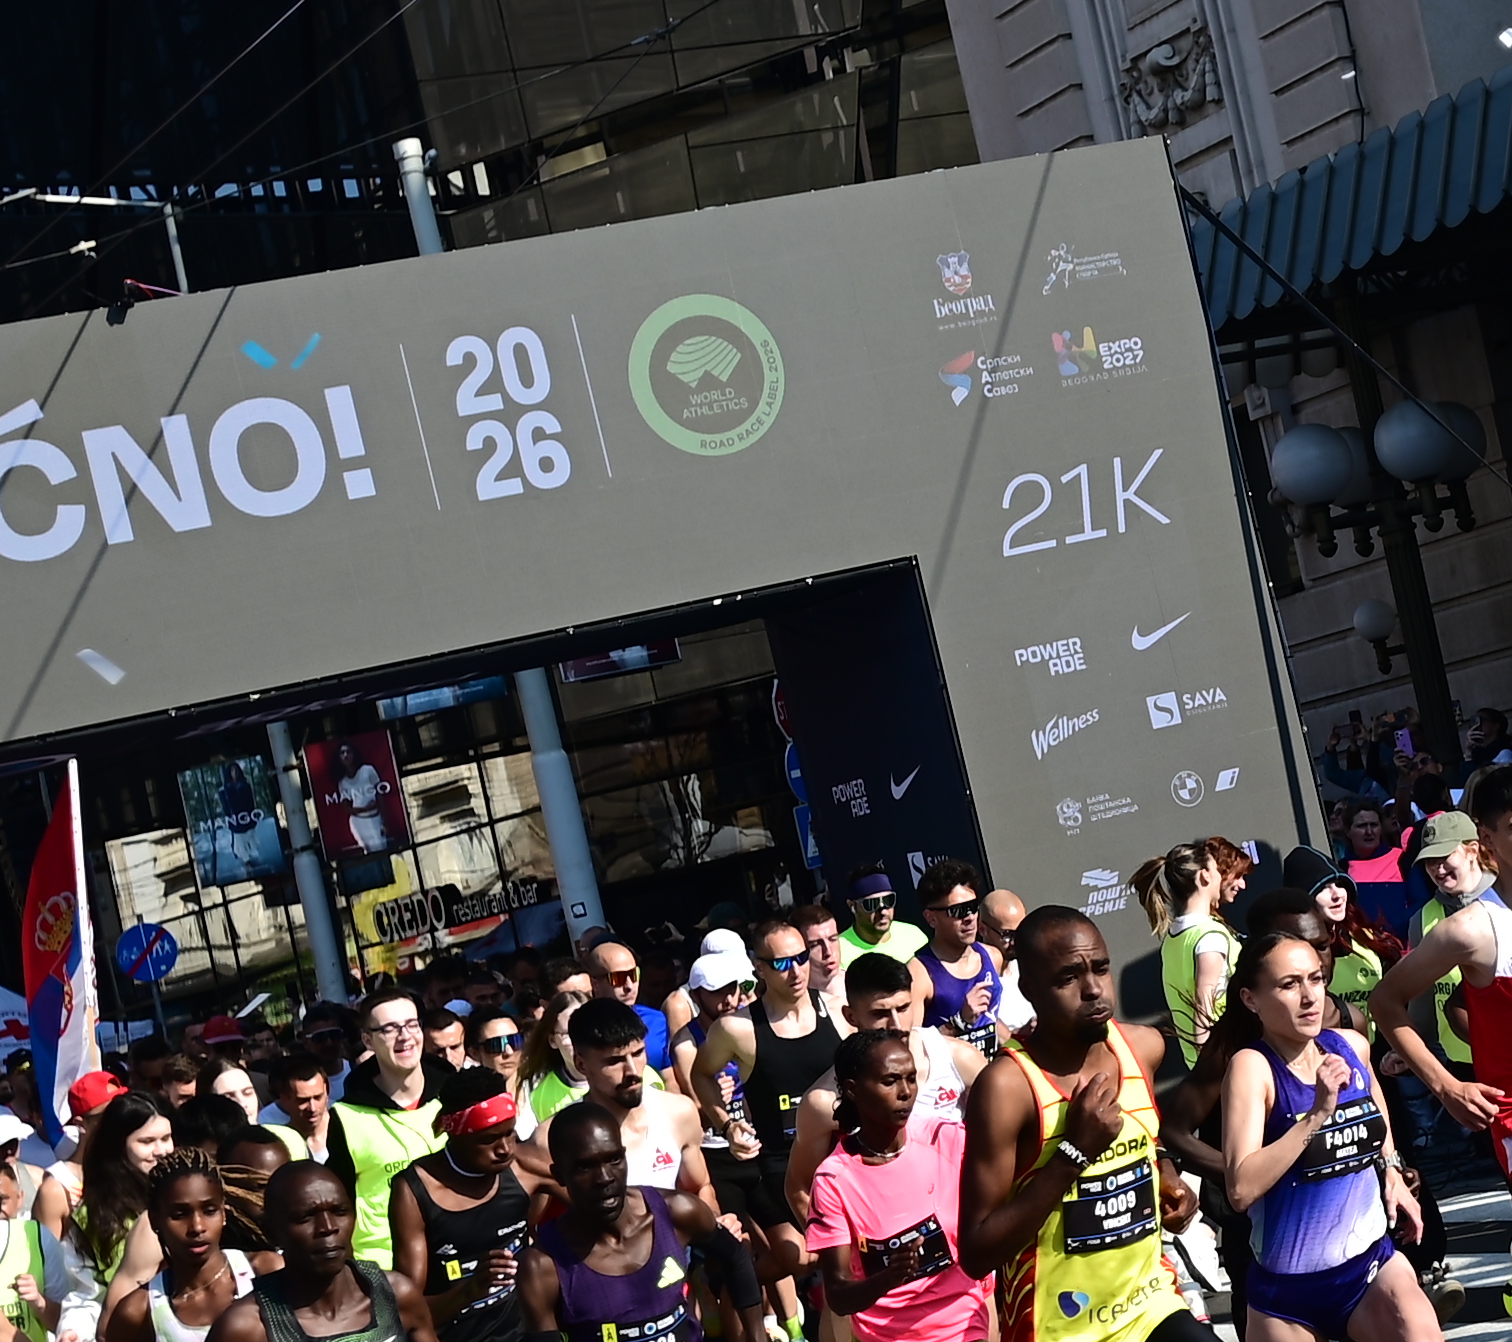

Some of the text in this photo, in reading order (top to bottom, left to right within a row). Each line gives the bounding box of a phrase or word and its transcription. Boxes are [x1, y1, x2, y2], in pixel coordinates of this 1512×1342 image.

[933, 294, 995, 318] Београд
[1099, 337, 1142, 356] EXPO
[444, 326, 551, 416] 20
[1102, 350, 1144, 370] 2027
[689, 388, 734, 405] WORLD
[700, 339, 779, 450] ROAD RACE LABEL 2026
[682, 397, 748, 419] ATHLETICS
[463, 411, 572, 503] 26
[1001, 447, 1171, 558] 21K
[1014, 636, 1083, 667] POWER
[1048, 655, 1087, 677] ADE
[1182, 687, 1228, 710] SAVA
[1030, 707, 1101, 761] Wellness
[324, 781, 391, 807] MANGO
[831, 778, 866, 805] POWER
[199, 808, 265, 832] MANGO
[850, 797, 871, 818] ADE
[373, 889, 446, 944] CREDO
[452, 890, 508, 923] restaurant
[520, 880, 537, 905] bar
[1325, 1123, 1368, 1150] F4014
[1094, 1190, 1137, 1217] 4009
